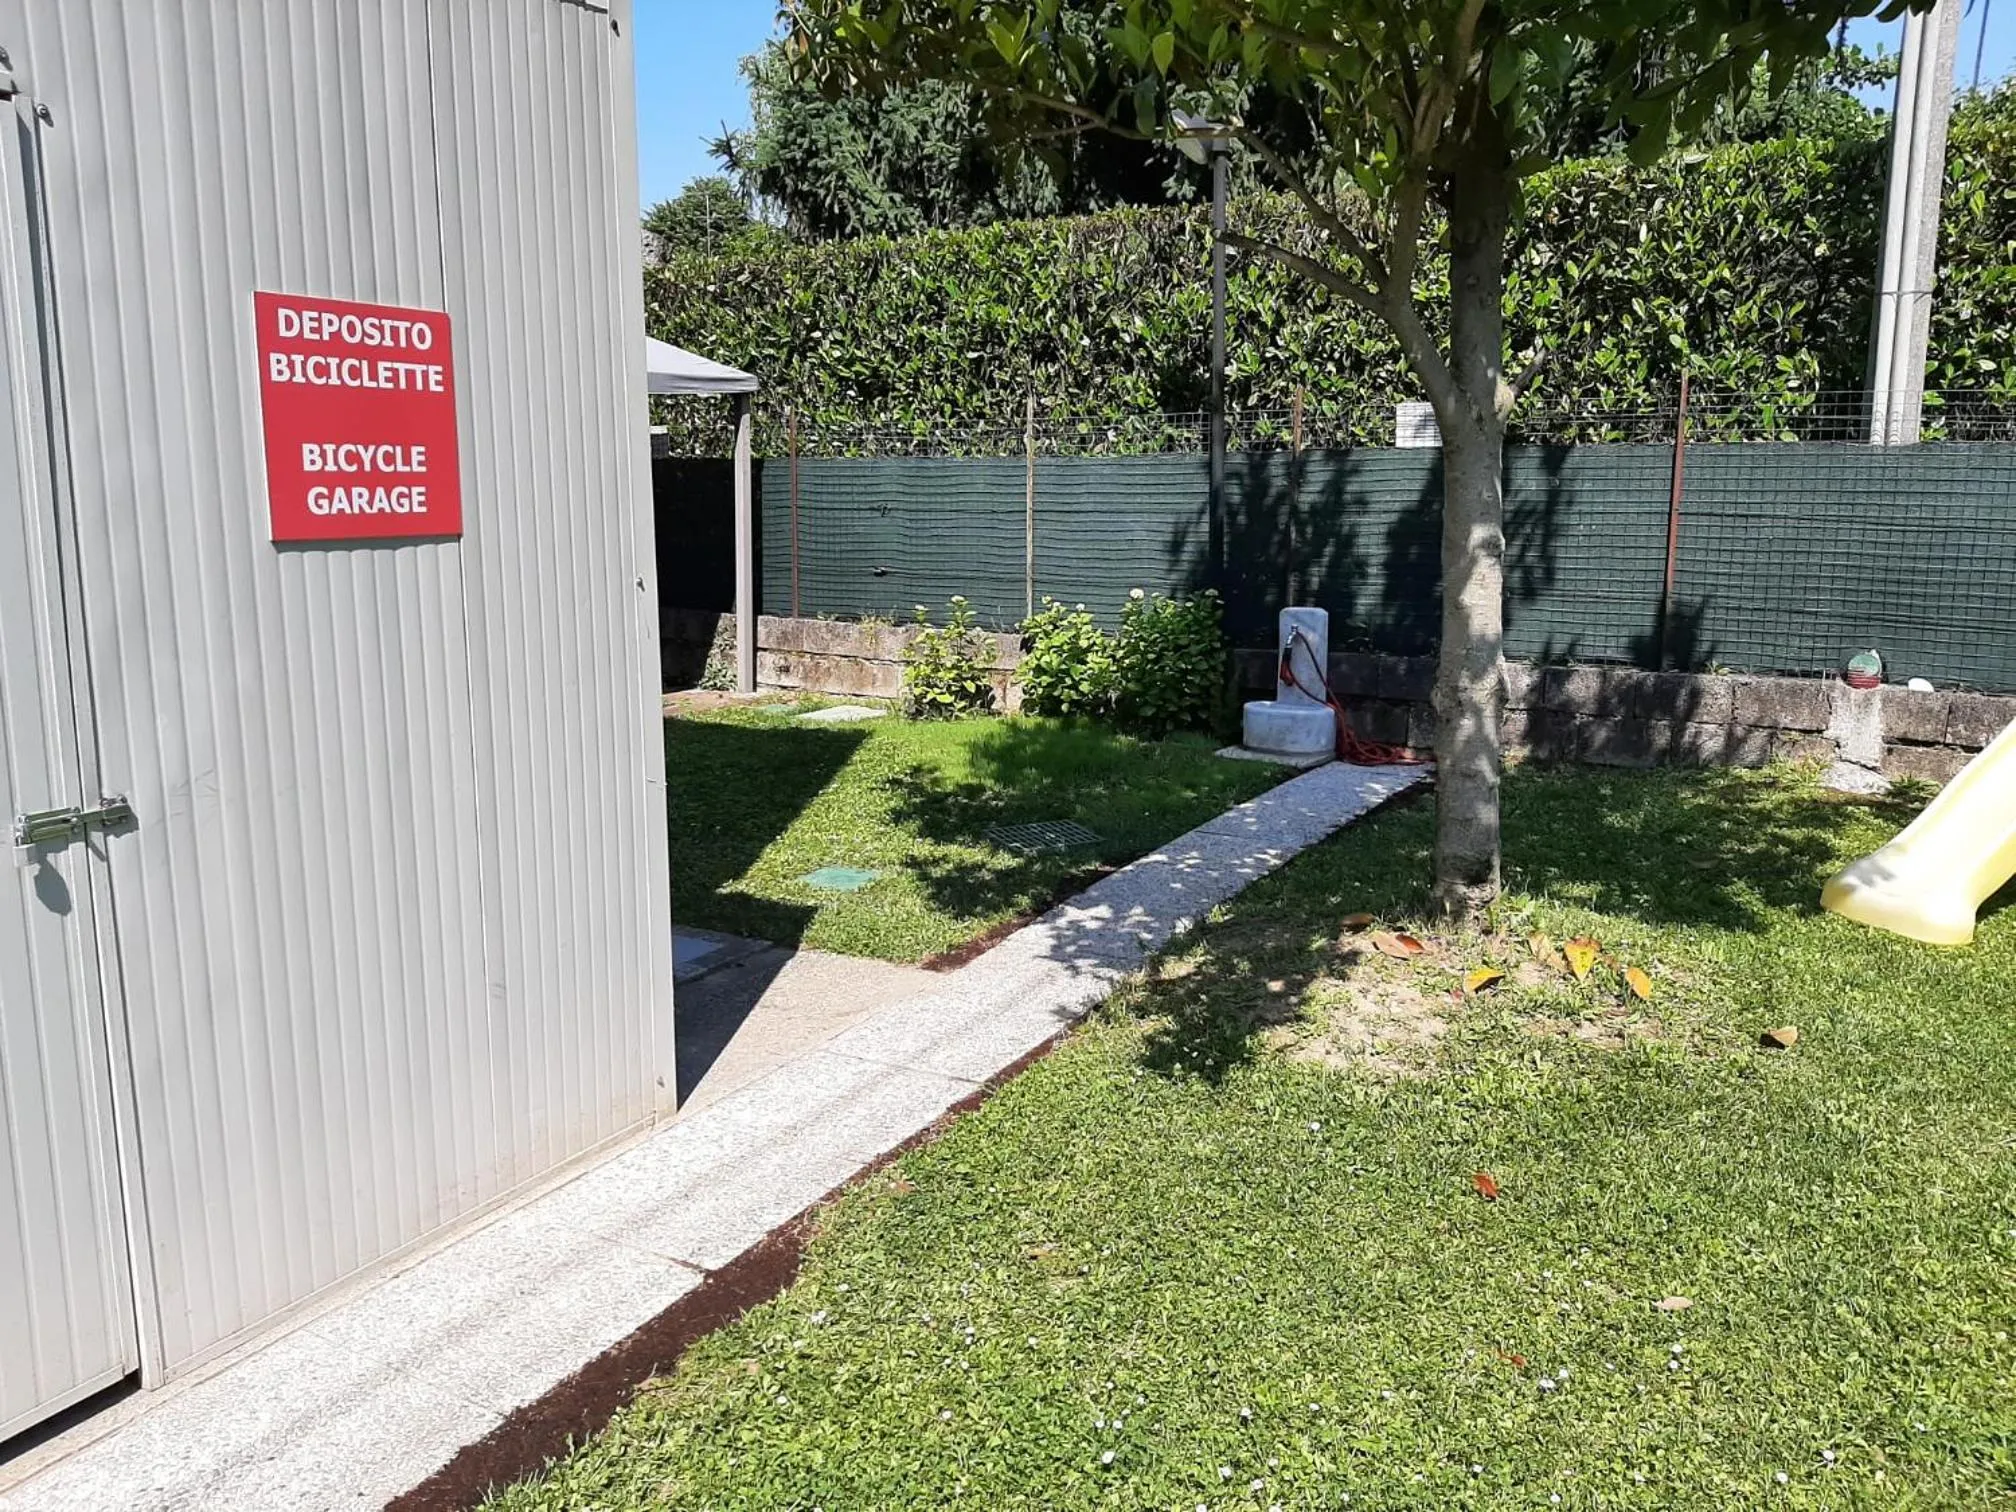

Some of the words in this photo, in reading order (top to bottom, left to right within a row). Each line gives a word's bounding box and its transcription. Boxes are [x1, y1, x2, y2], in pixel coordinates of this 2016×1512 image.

[277, 307, 432, 350] DEPOSITO
[269, 352, 444, 392] BICICLETTE
[302, 443, 427, 473] BICYCLE
[307, 486, 427, 515] GARAGE
